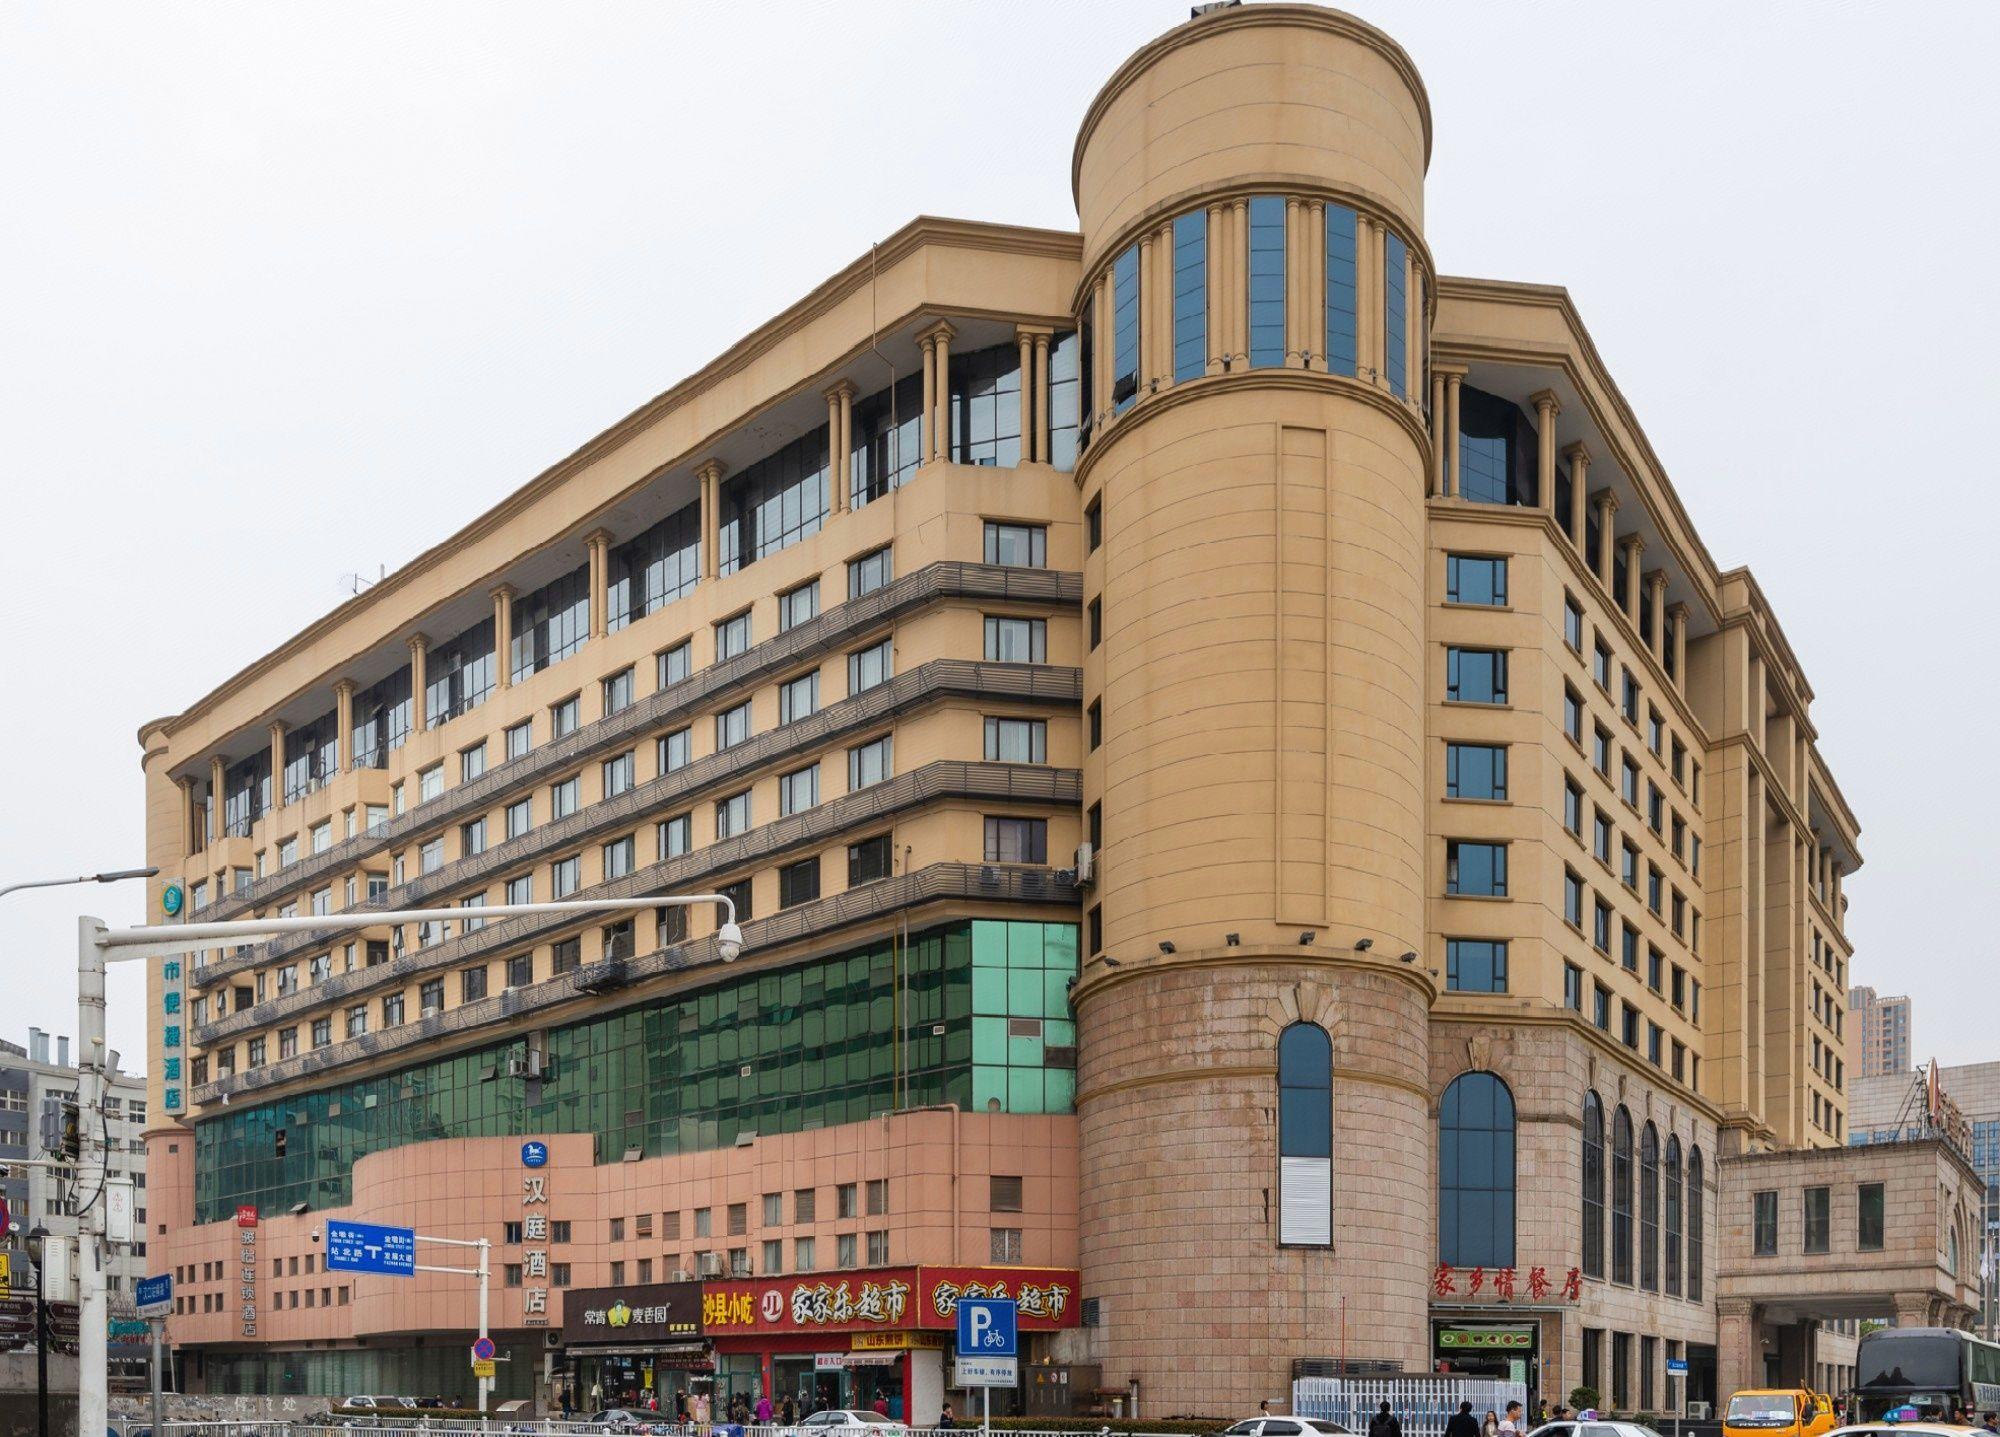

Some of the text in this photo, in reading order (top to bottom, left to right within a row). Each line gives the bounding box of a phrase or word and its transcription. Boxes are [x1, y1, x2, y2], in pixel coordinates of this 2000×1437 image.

[523, 1176, 547, 1315] 汉庭酒店
[1434, 1261, 1583, 1300] 家乡情餐厅
[632, 1306, 667, 1324] 麦香园
[703, 1292, 755, 1325] 沙县小吃
[791, 1281, 909, 1325] 家家乐超市
[970, 1306, 992, 1347] P
